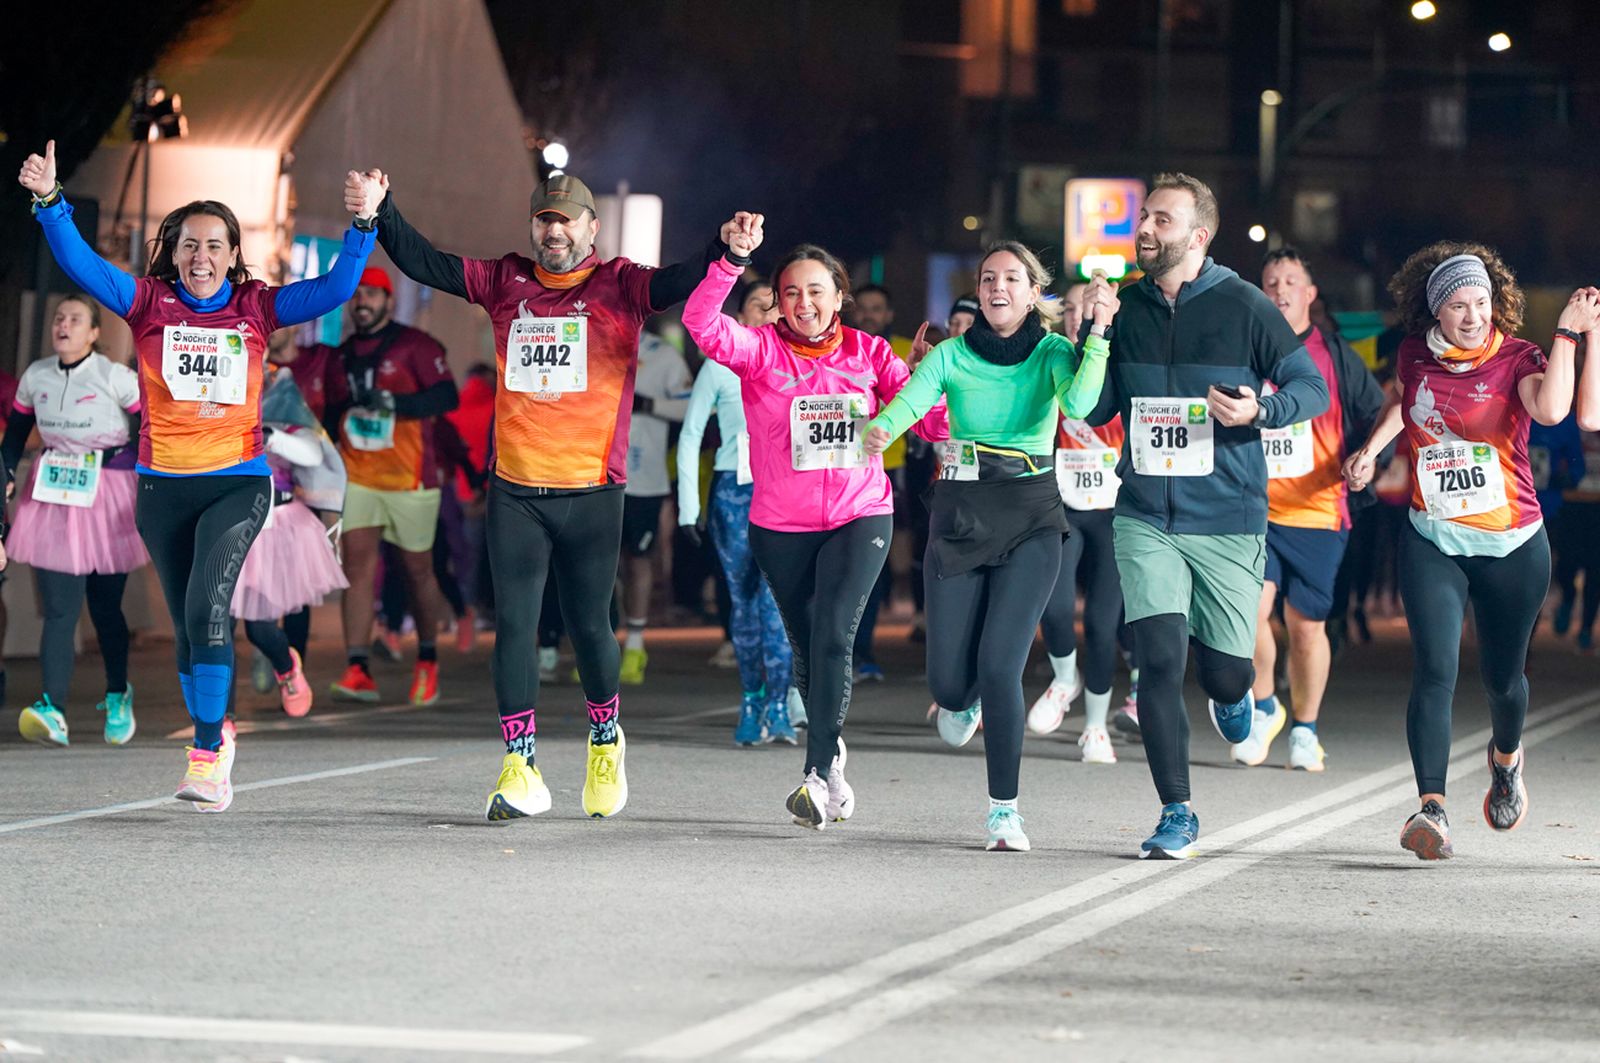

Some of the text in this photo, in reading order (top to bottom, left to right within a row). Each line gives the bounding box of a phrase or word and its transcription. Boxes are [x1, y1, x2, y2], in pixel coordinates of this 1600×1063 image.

[546, 326, 555, 334] DE
[183, 335, 217, 344] NOCHE DE
[172, 343, 189, 352] SAN
[521, 344, 571, 367] 3442
[178, 353, 232, 378] 3440
[809, 402, 843, 411] NOCHE DE
[1148, 406, 1181, 415] NOCHE DE
[800, 412, 817, 421] SAN
[1139, 415, 1153, 424] SAN
[1424, 416, 1445, 435] 43
[809, 421, 855, 445] 3441
[1151, 425, 1188, 449] 318
[1263, 439, 1293, 456] 788
[1433, 449, 1455, 460] NOCHE
[1456, 448, 1466, 457] DE
[1425, 461, 1442, 472] SAN
[1074, 471, 1103, 489] 789
[1435, 466, 1486, 493] 7206
[217, 491, 268, 600] ARMOUR
